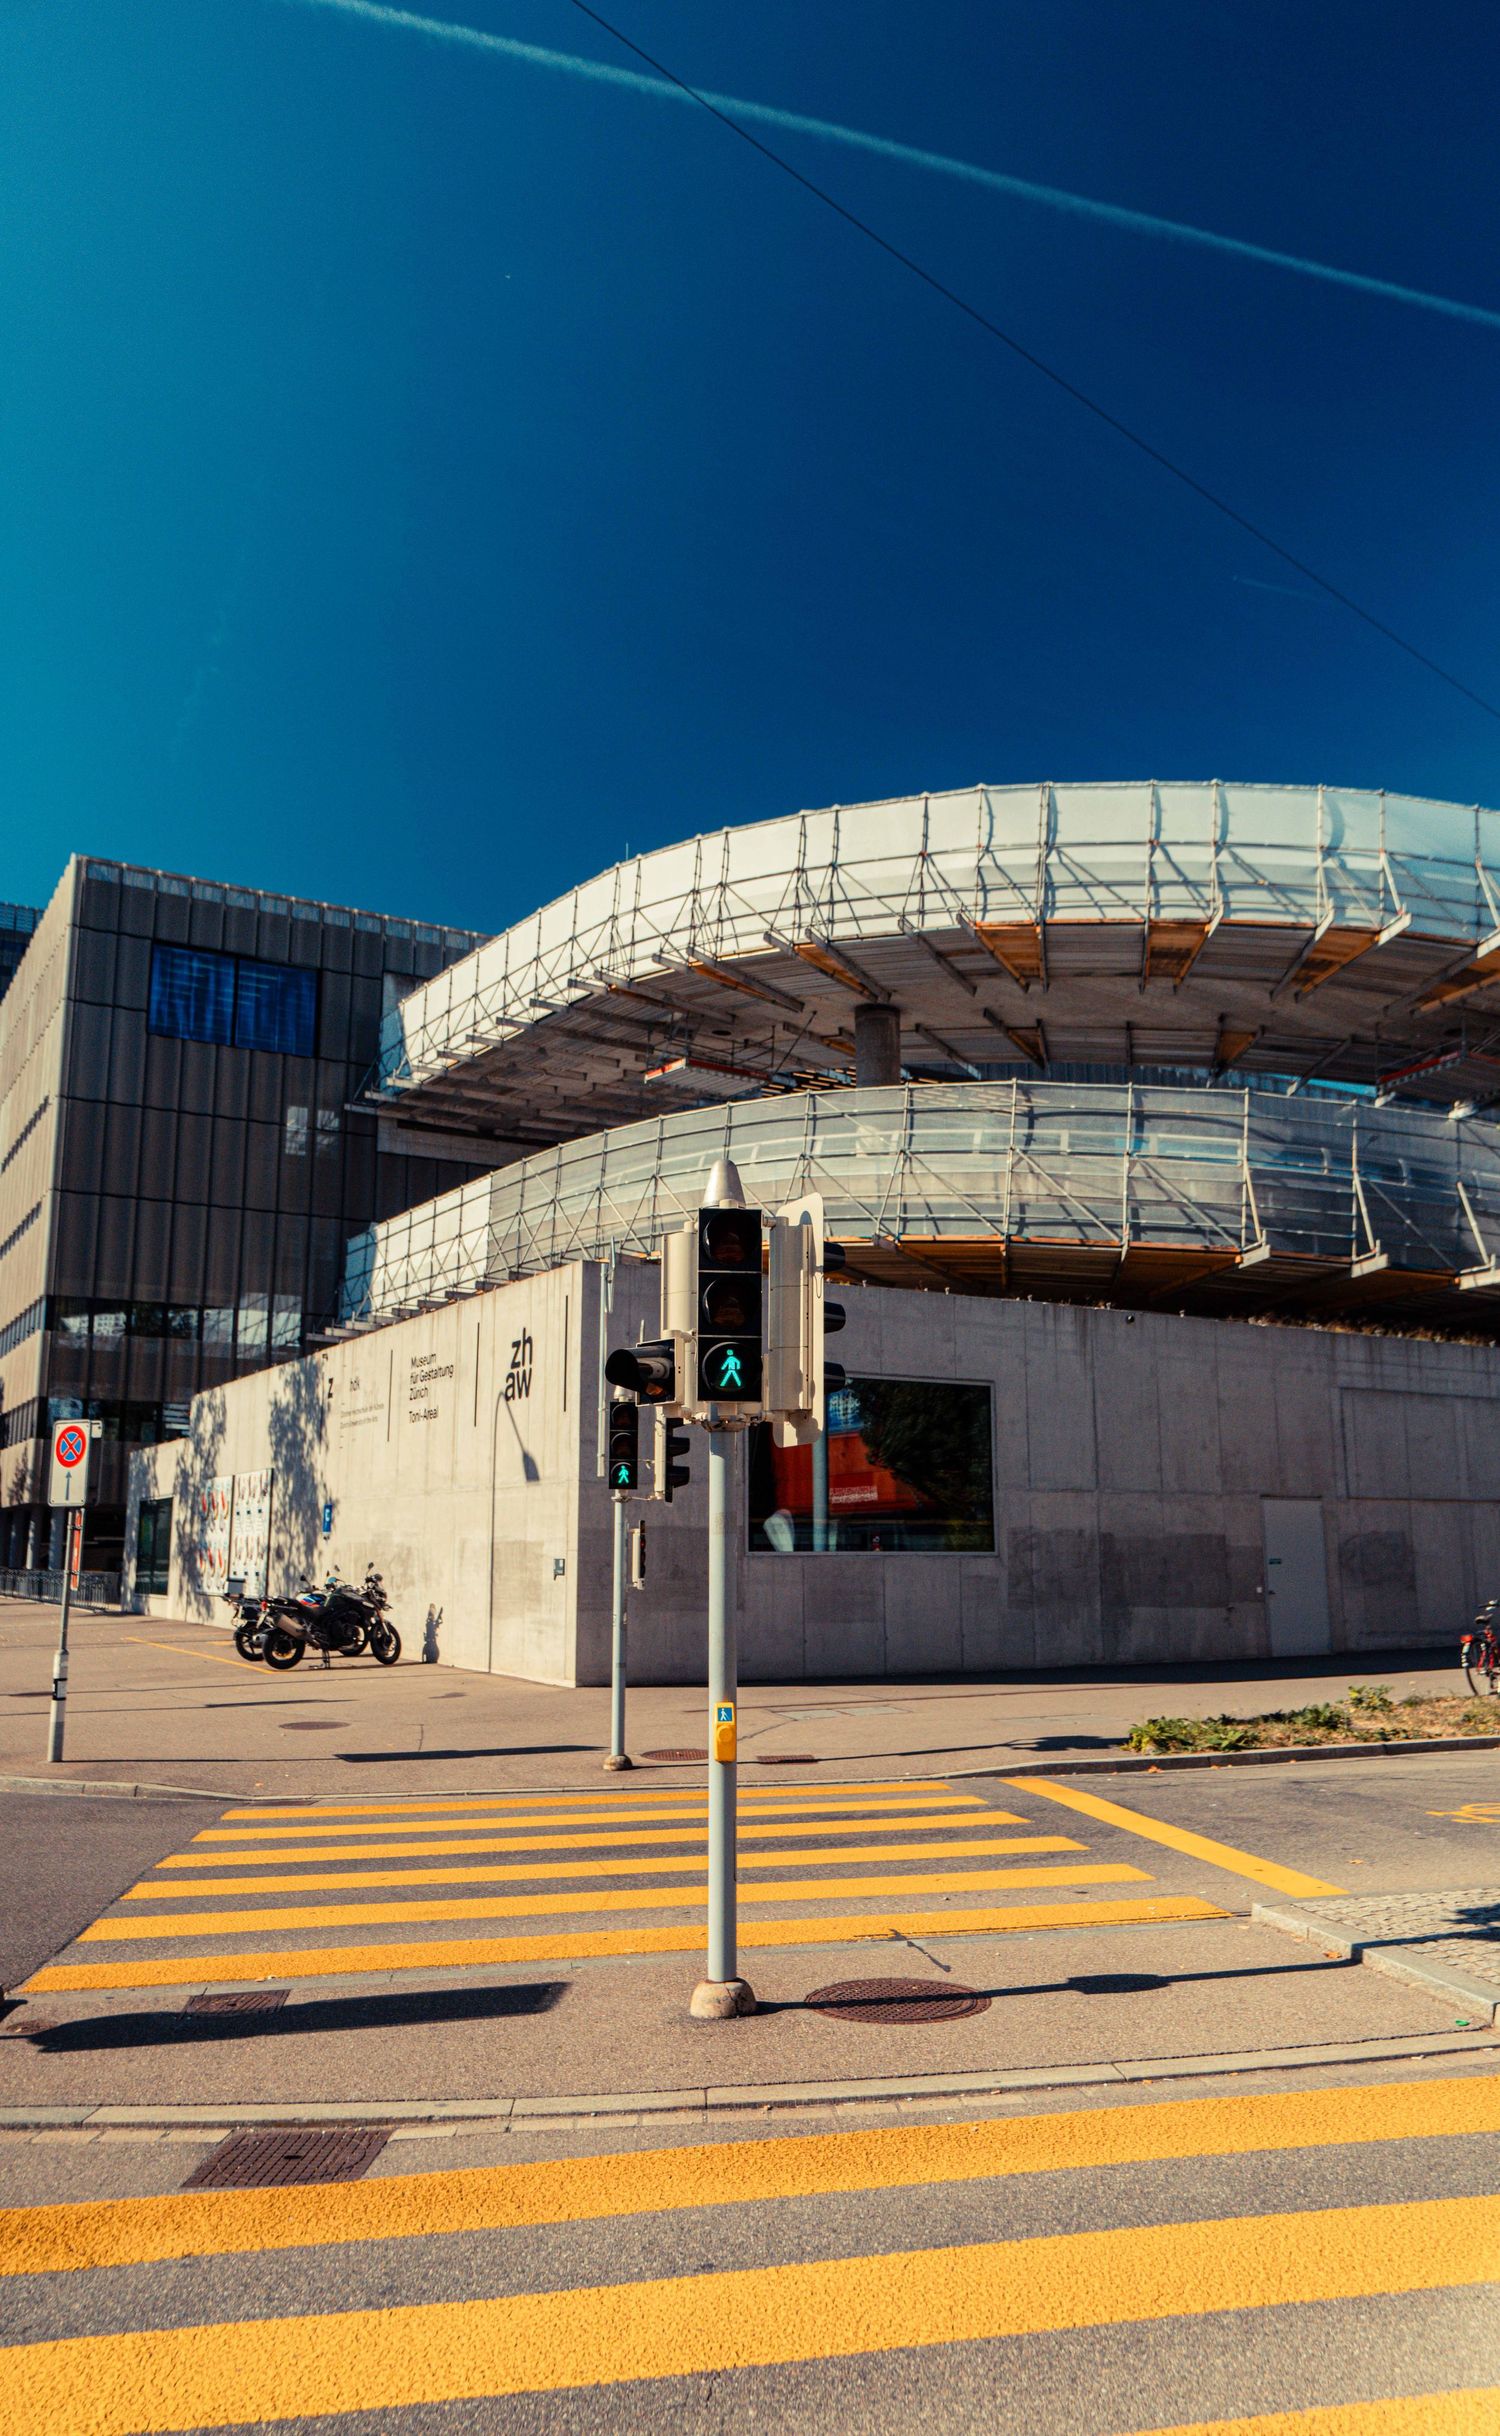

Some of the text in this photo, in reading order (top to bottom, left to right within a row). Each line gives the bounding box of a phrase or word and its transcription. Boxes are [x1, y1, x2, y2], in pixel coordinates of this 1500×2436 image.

[511, 1327, 533, 1369] zh
[411, 1353, 437, 1369] Museum
[420, 1364, 454, 1382] Gestaltung
[409, 1386, 428, 1401] Zürich
[505, 1367, 532, 1402] aw
[409, 1405, 439, 1423] Toni-Areal
